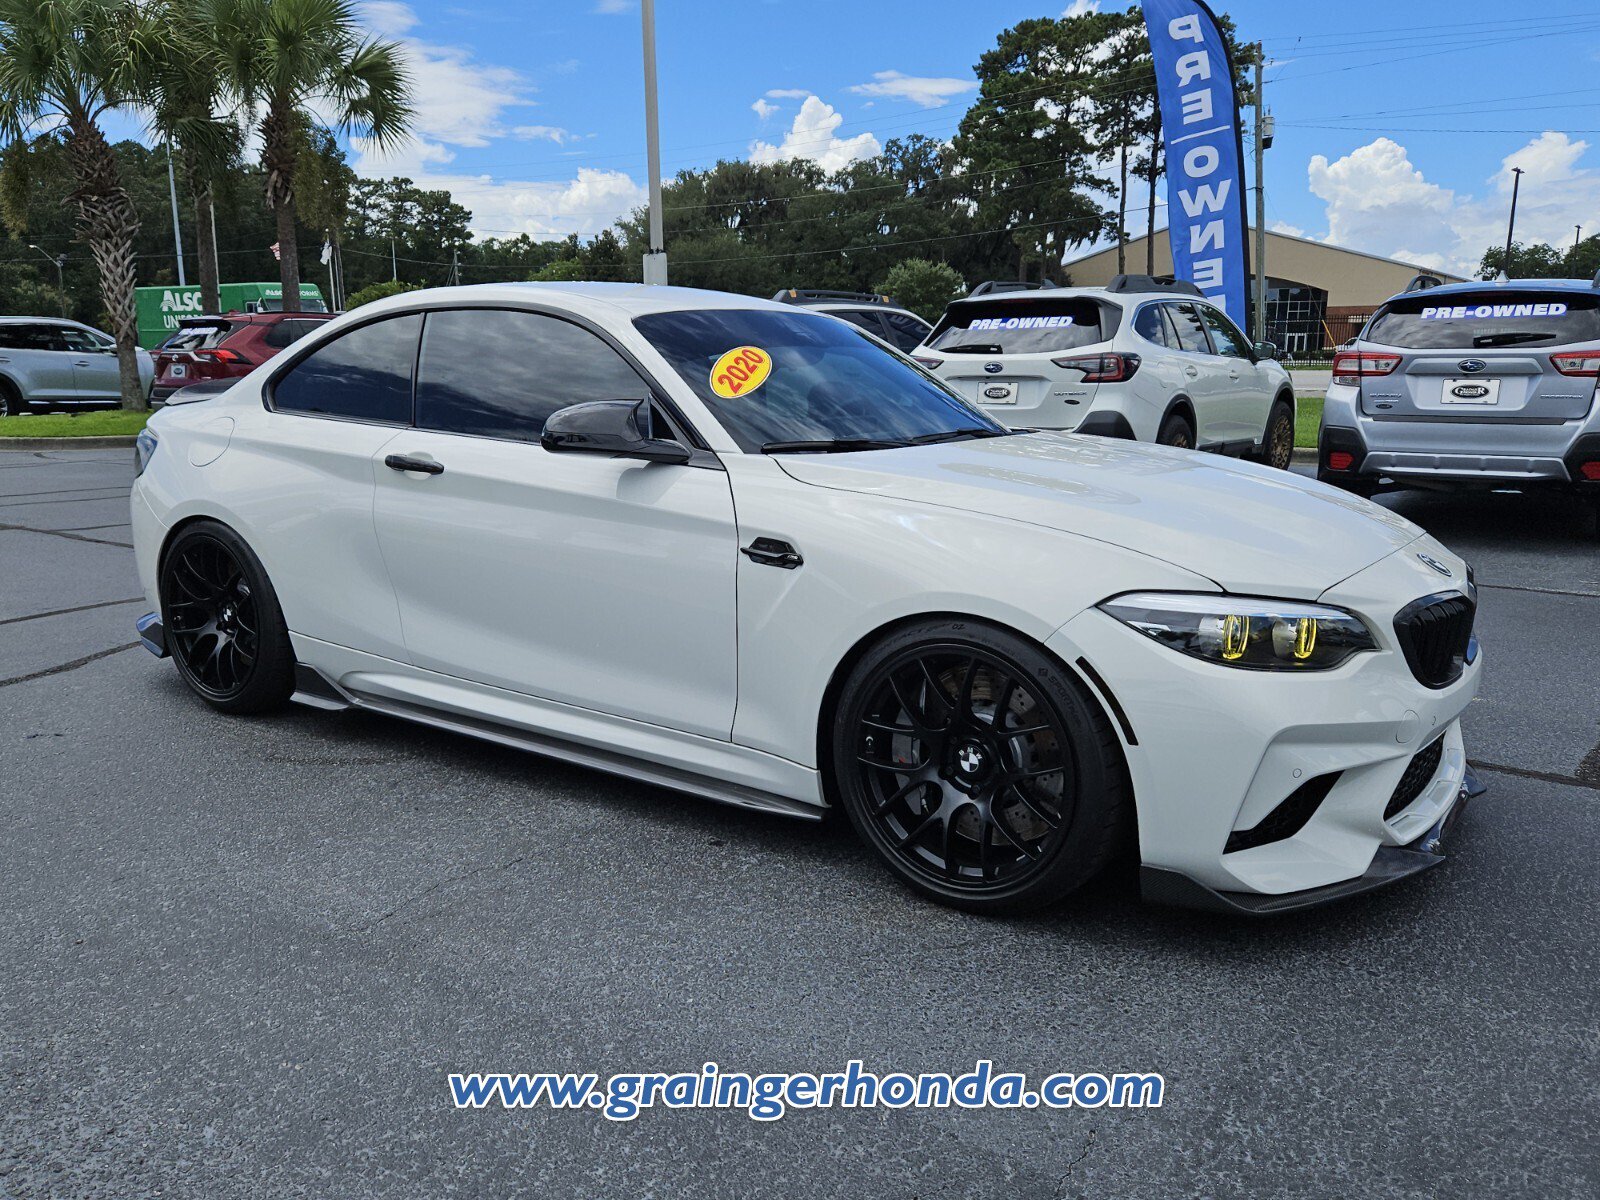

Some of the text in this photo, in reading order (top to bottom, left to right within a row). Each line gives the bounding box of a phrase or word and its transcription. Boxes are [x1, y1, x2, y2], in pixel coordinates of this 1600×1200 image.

[160, 290, 203, 311] ALSC
[1421, 303, 1567, 319] PRE-OWNED
[968, 316, 1073, 330] PRE-OWNED
[717, 349, 763, 394] 2020
